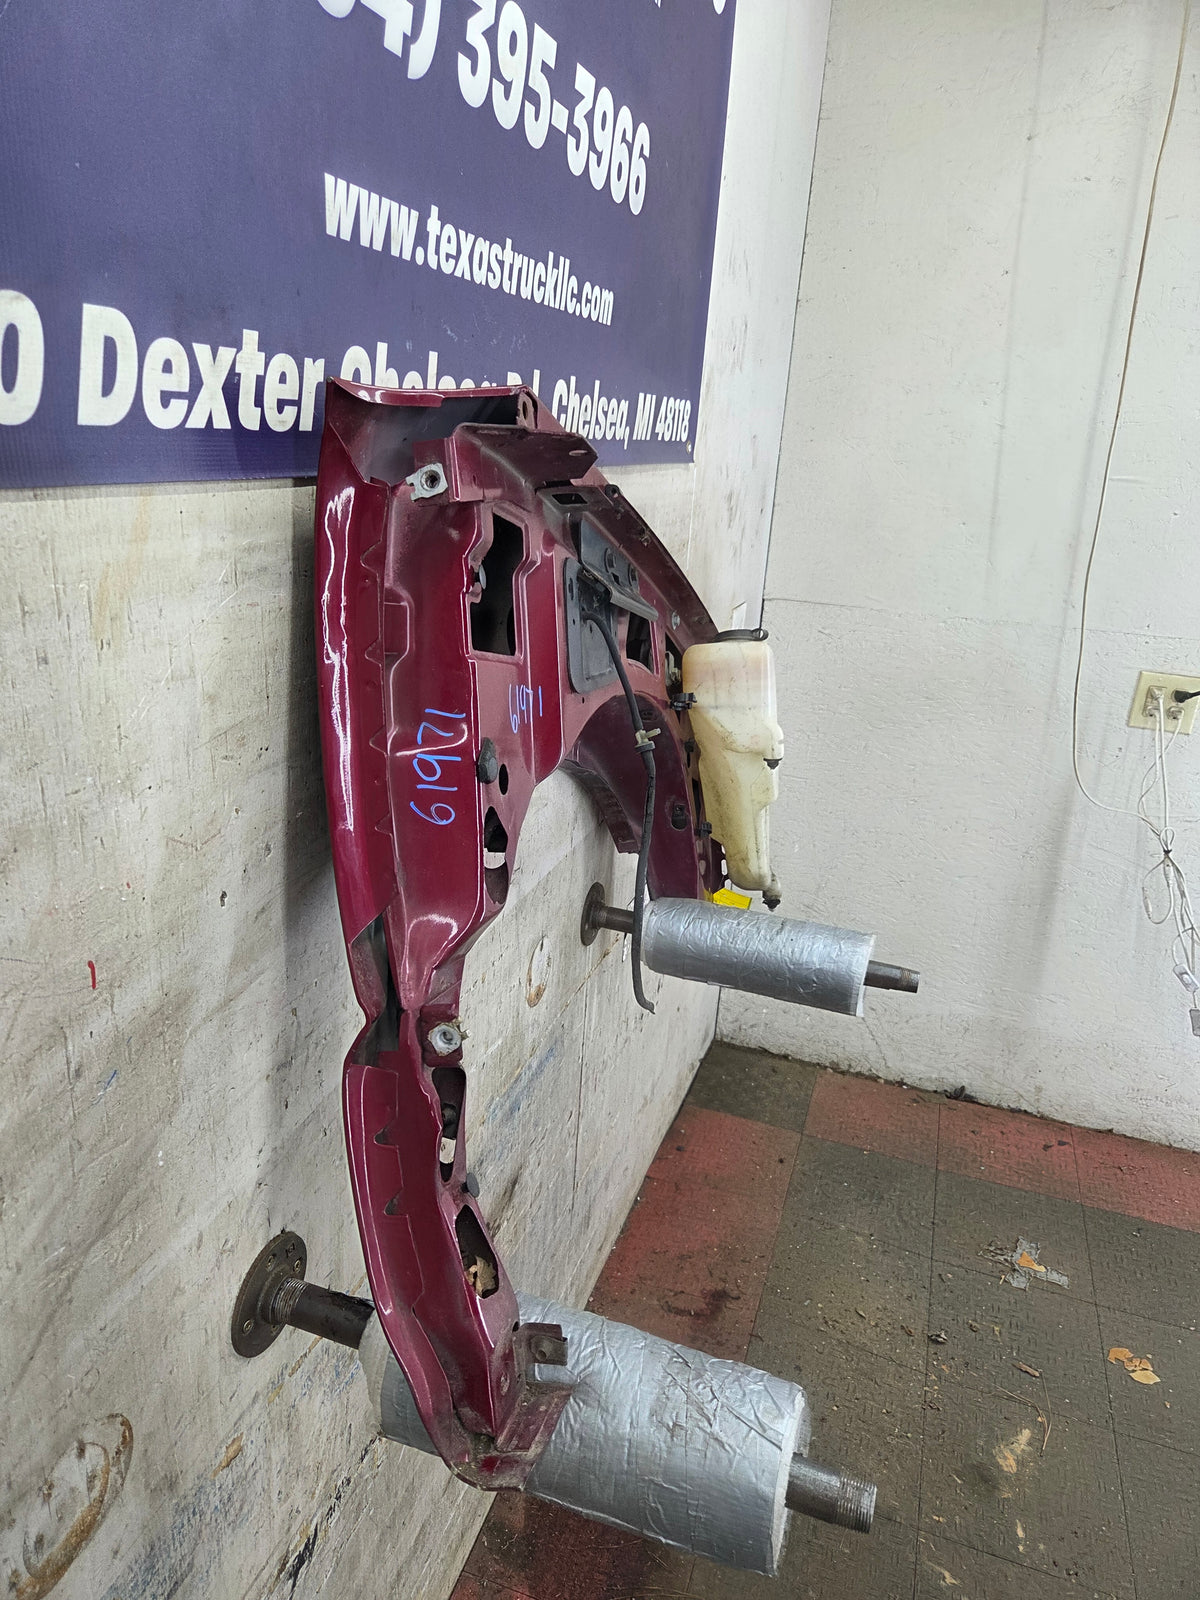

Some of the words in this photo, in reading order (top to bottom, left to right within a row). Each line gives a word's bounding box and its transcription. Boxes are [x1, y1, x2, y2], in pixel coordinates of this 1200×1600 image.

[457, 0, 650, 216] 395-3966
[324, 172, 614, 326] www.texastruckllc.com
[77, 303, 325, 433] Dexter
[552, 375, 630, 450] Chelsea,
[632, 392, 657, 440] MI
[655, 396, 692, 442] 48118
[410, 708, 467, 826] 61971
